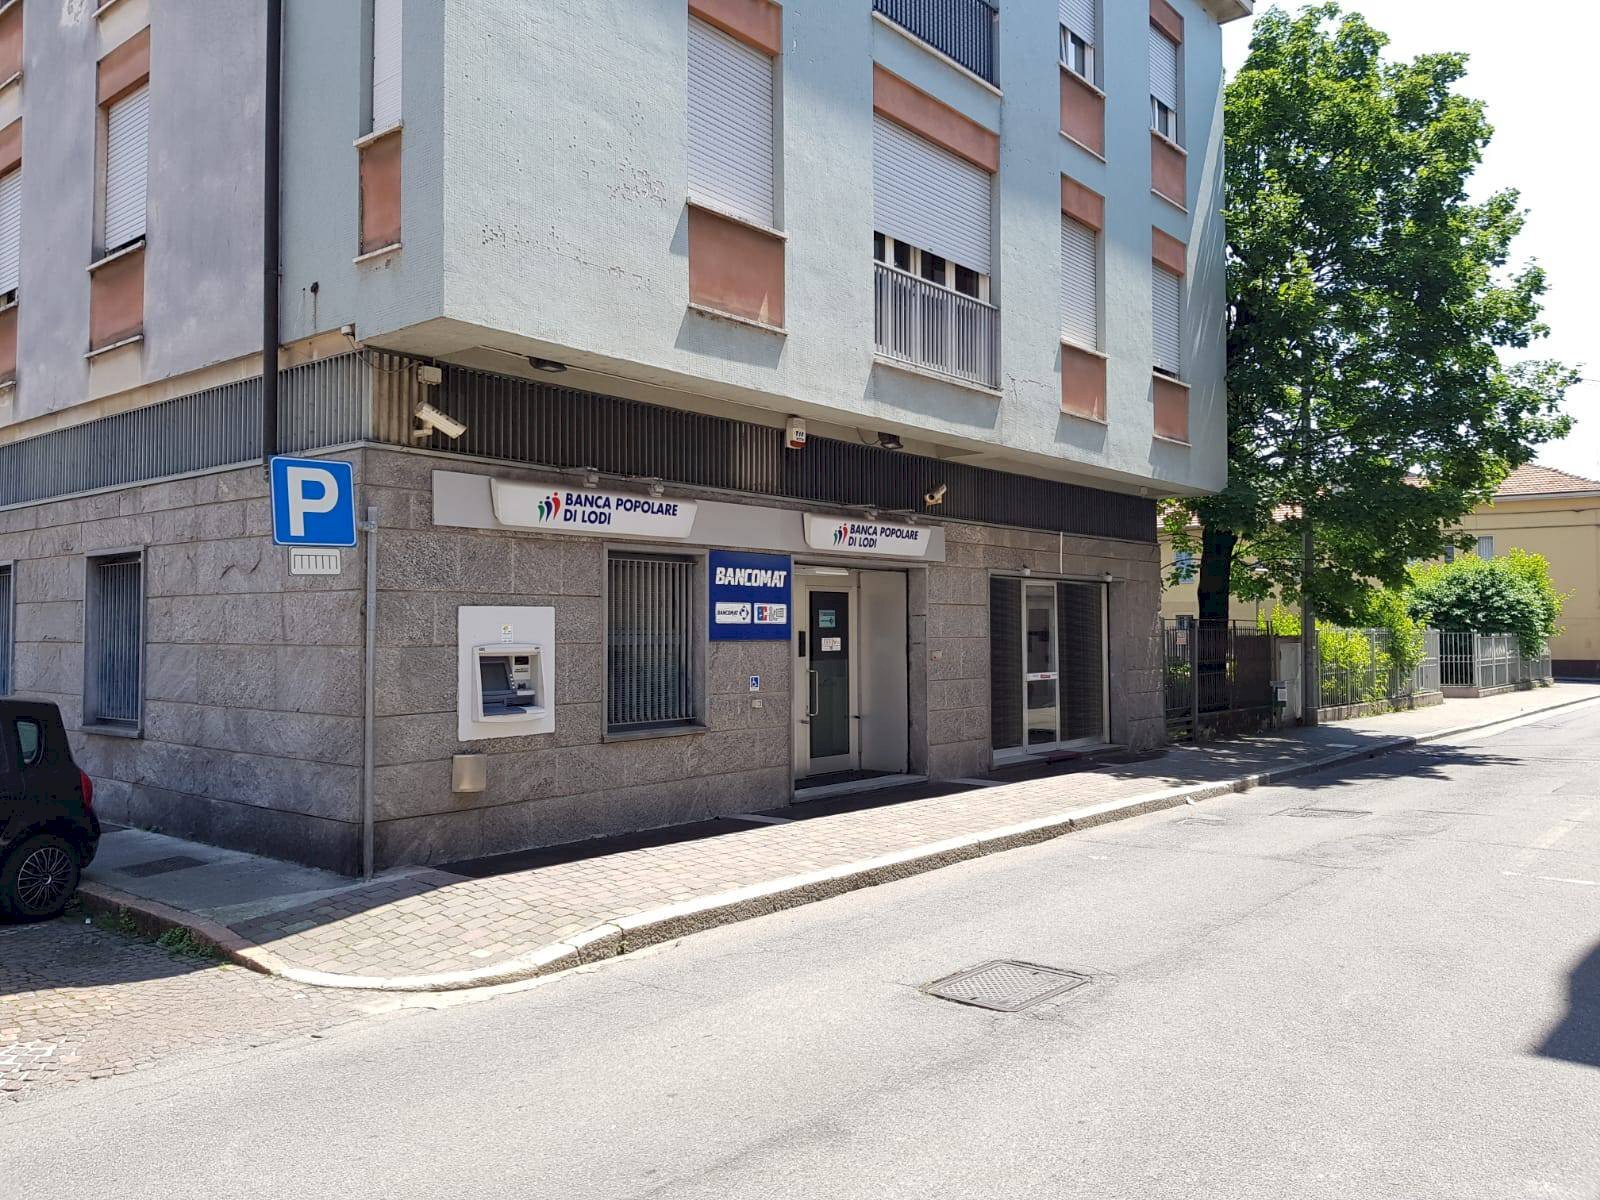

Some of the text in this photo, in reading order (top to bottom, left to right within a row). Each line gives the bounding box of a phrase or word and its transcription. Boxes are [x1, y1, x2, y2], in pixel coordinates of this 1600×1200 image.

[287, 467, 338, 536] P
[565, 492, 678, 516] BANCA POPOLARE
[563, 508, 611, 525] DI LODI
[847, 535, 877, 548] DI LODI
[849, 524, 919, 540] BANCA POPOLARE
[715, 566, 787, 588] BANCOMAT
